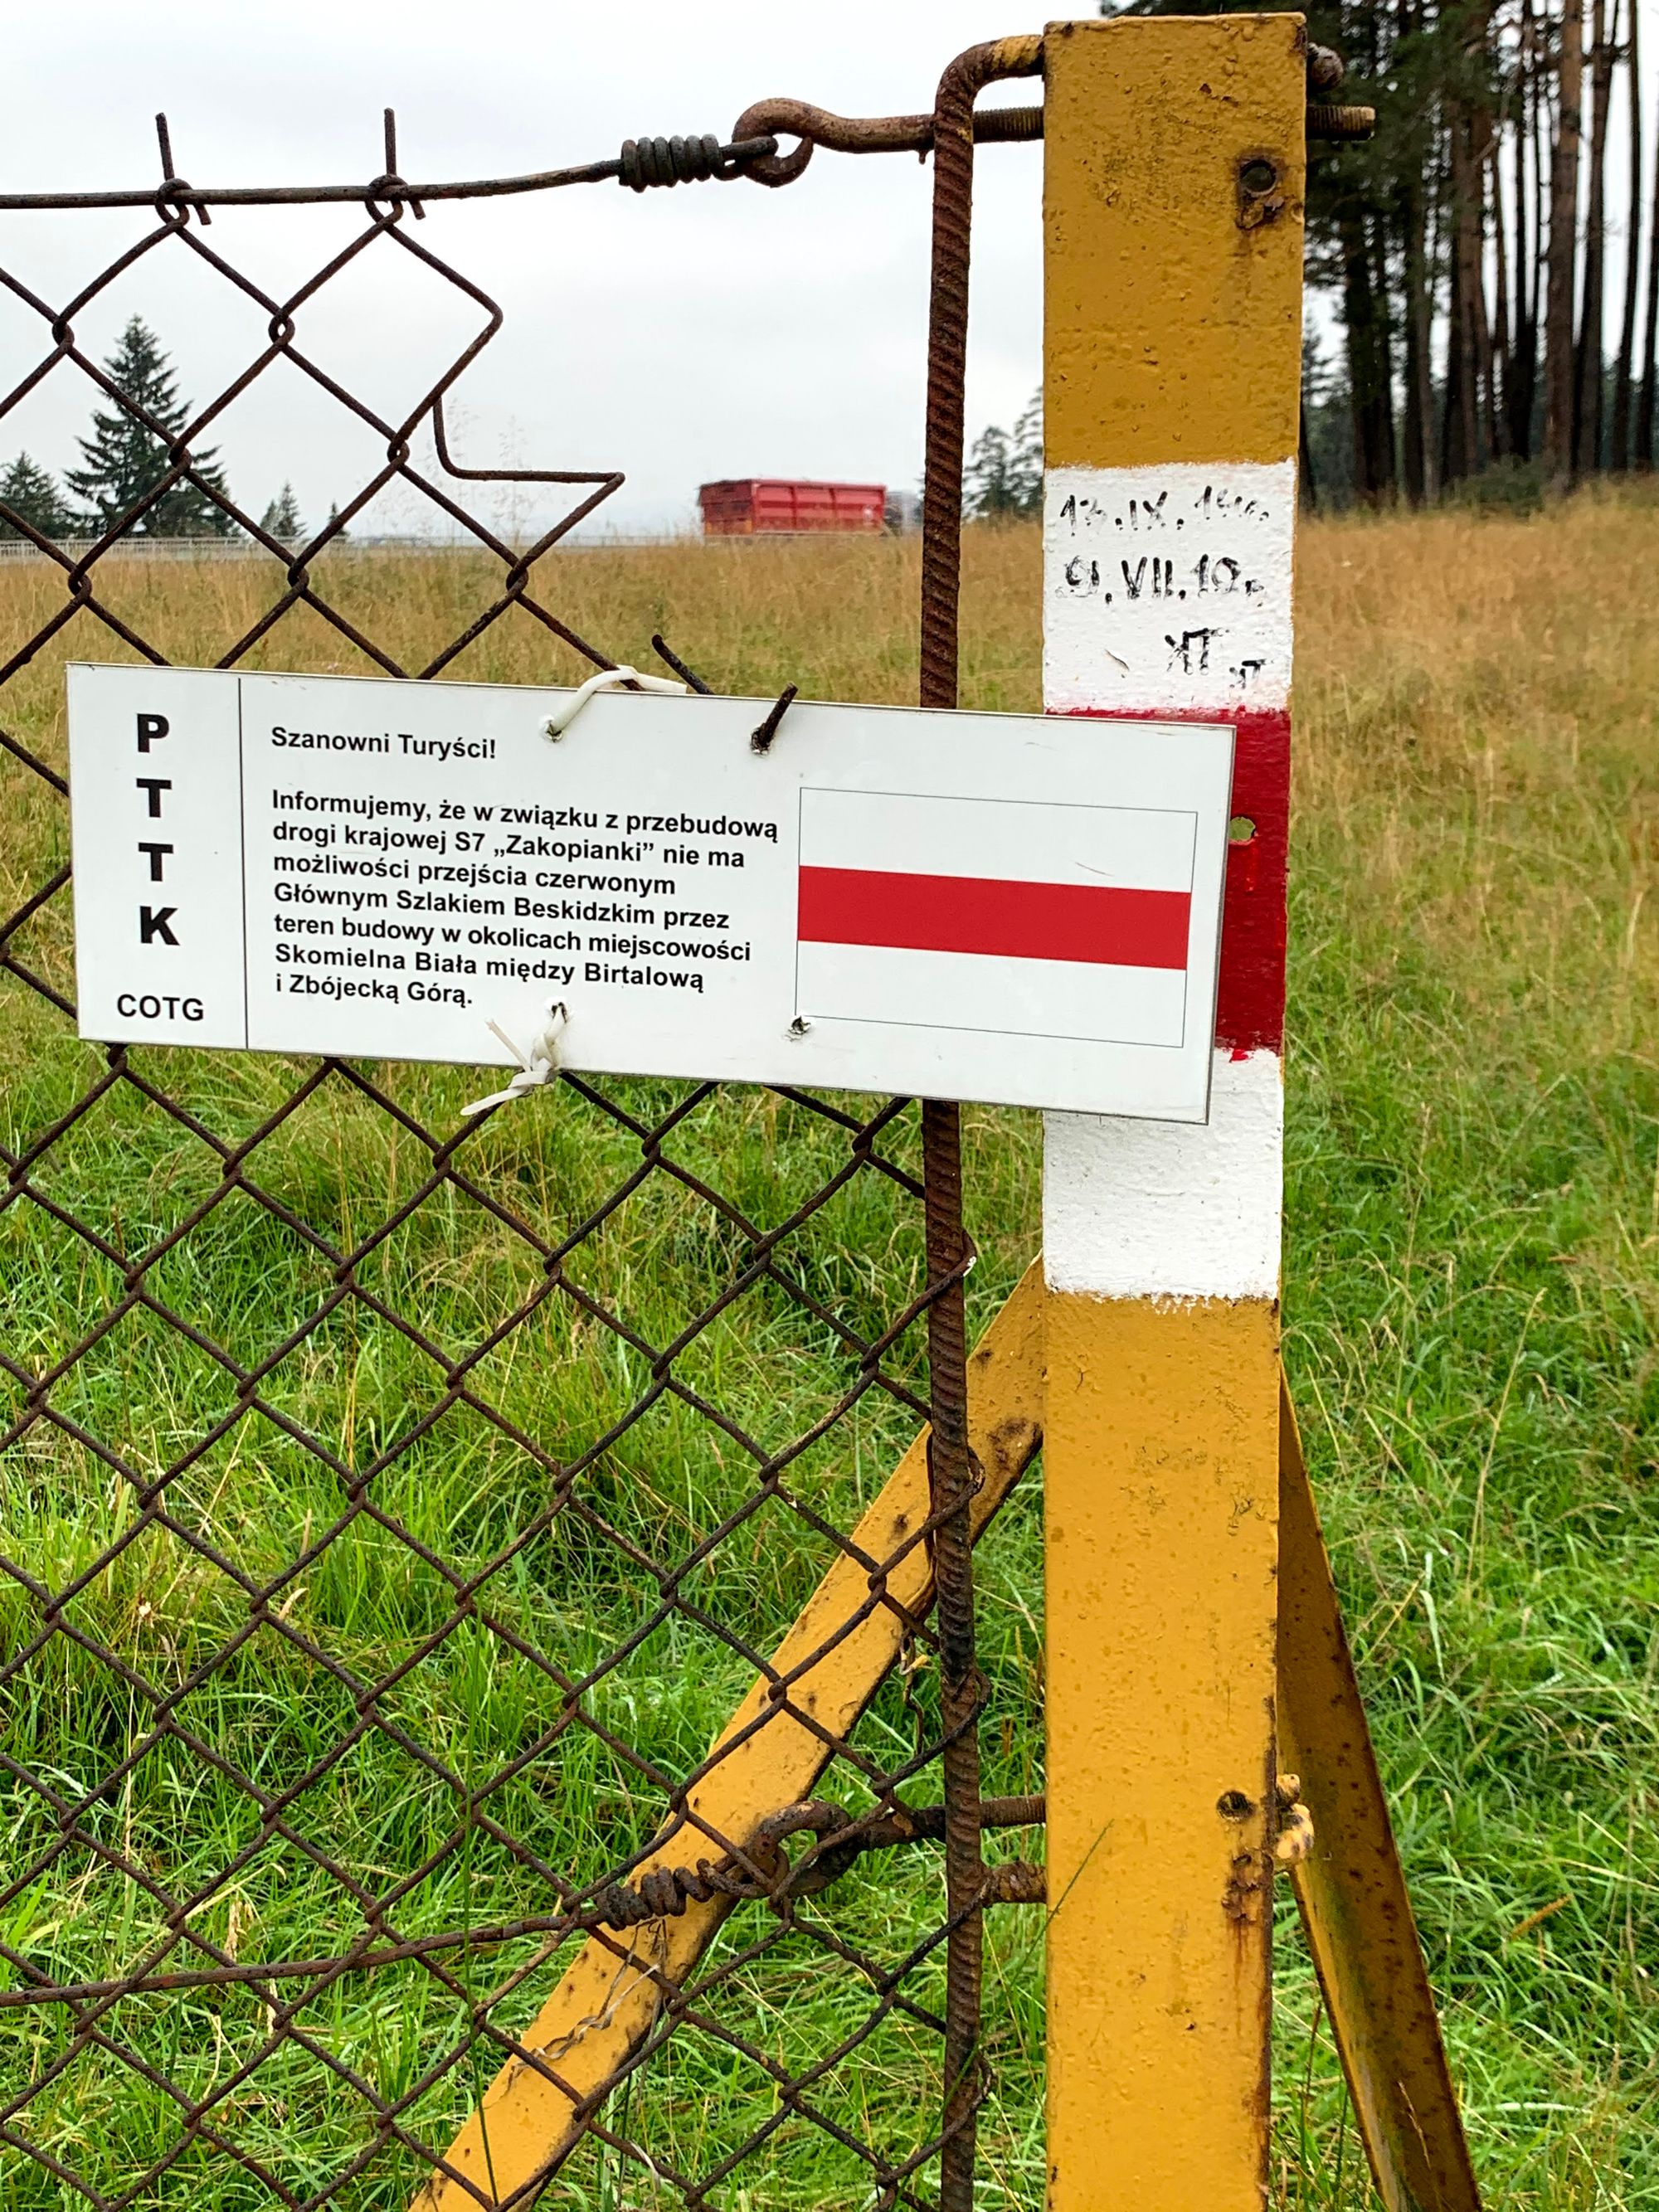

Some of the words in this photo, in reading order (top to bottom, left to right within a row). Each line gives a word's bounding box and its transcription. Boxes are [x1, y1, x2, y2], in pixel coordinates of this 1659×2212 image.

[271, 726, 390, 753] Szanowni
[397, 733, 495, 762] Turyści!
[136, 712, 179, 946] PTTK
[273, 789, 431, 823] Informujemy,
[439, 799, 466, 820] że
[473, 805, 494, 822] w
[500, 805, 598, 831] związku
[605, 814, 619, 829] z
[626, 813, 778, 843] przebudową
[273, 820, 336, 848] drogi
[344, 824, 446, 855] krajowej
[455, 831, 485, 852] S7
[664, 843, 700, 865] nie
[708, 851, 744, 868] ma
[274, 853, 409, 879] możliwości
[418, 863, 528, 888] przejścia
[535, 872, 675, 898] czerwonym
[274, 882, 387, 912] Głównym
[397, 889, 505, 916] Szlakiem
[514, 897, 654, 925] Beskidzkim
[664, 911, 730, 931] przez
[274, 913, 334, 936] teren
[342, 916, 435, 946] budowy
[441, 927, 462, 943] w
[468, 926, 581, 950] okolicach
[589, 933, 751, 961] miejscowości
[275, 943, 406, 970] Skomielna
[416, 951, 477, 975] Biała
[486, 957, 576, 985] między
[585, 962, 704, 994] Birtalową
[276, 973, 281, 992] i
[289, 974, 400, 1004] Zbójecką
[407, 981, 472, 1009] Górą.
[117, 994, 204, 1021] COTG
